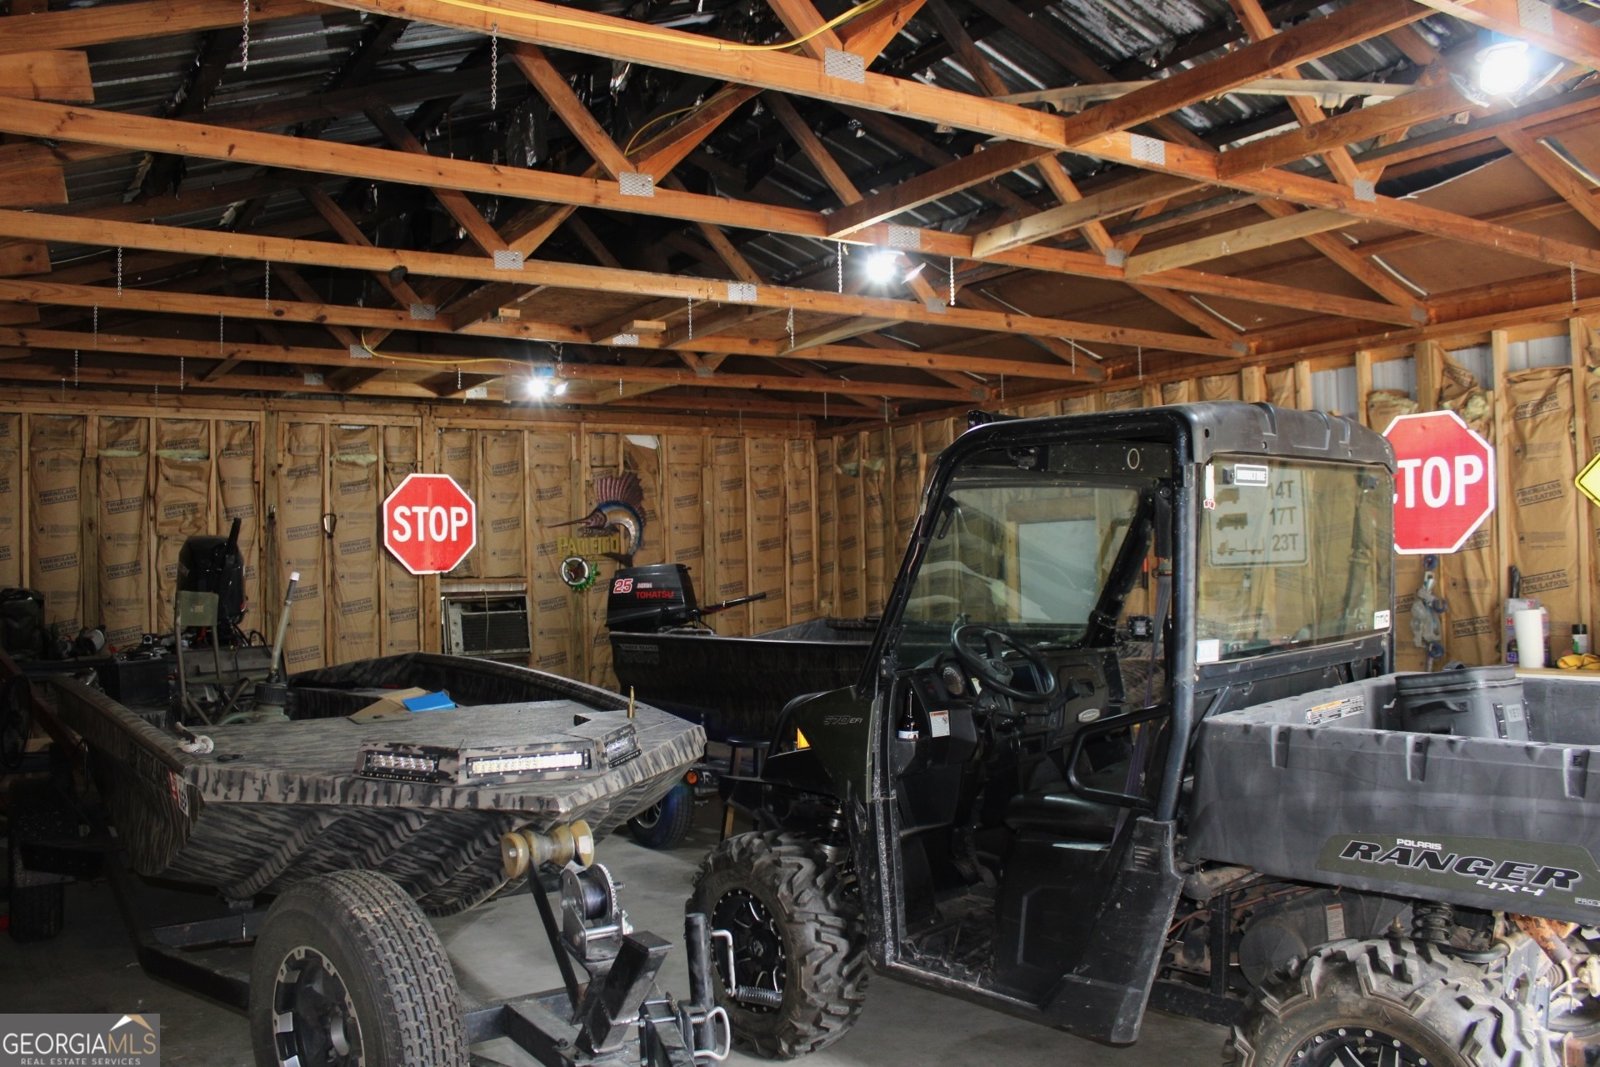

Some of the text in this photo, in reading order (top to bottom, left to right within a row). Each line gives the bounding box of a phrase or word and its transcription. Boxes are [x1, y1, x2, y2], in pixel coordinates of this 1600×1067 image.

[1393, 454, 1484, 508] TOP
[392, 505, 469, 543] STOP
[1269, 506, 1297, 525] 17T
[1272, 533, 1299, 552] 23T
[613, 578, 634, 594] 25
[635, 590, 675, 599] TOHATSU
[1396, 838, 1442, 851] POLARIS
[1339, 839, 1582, 891] RANGER
